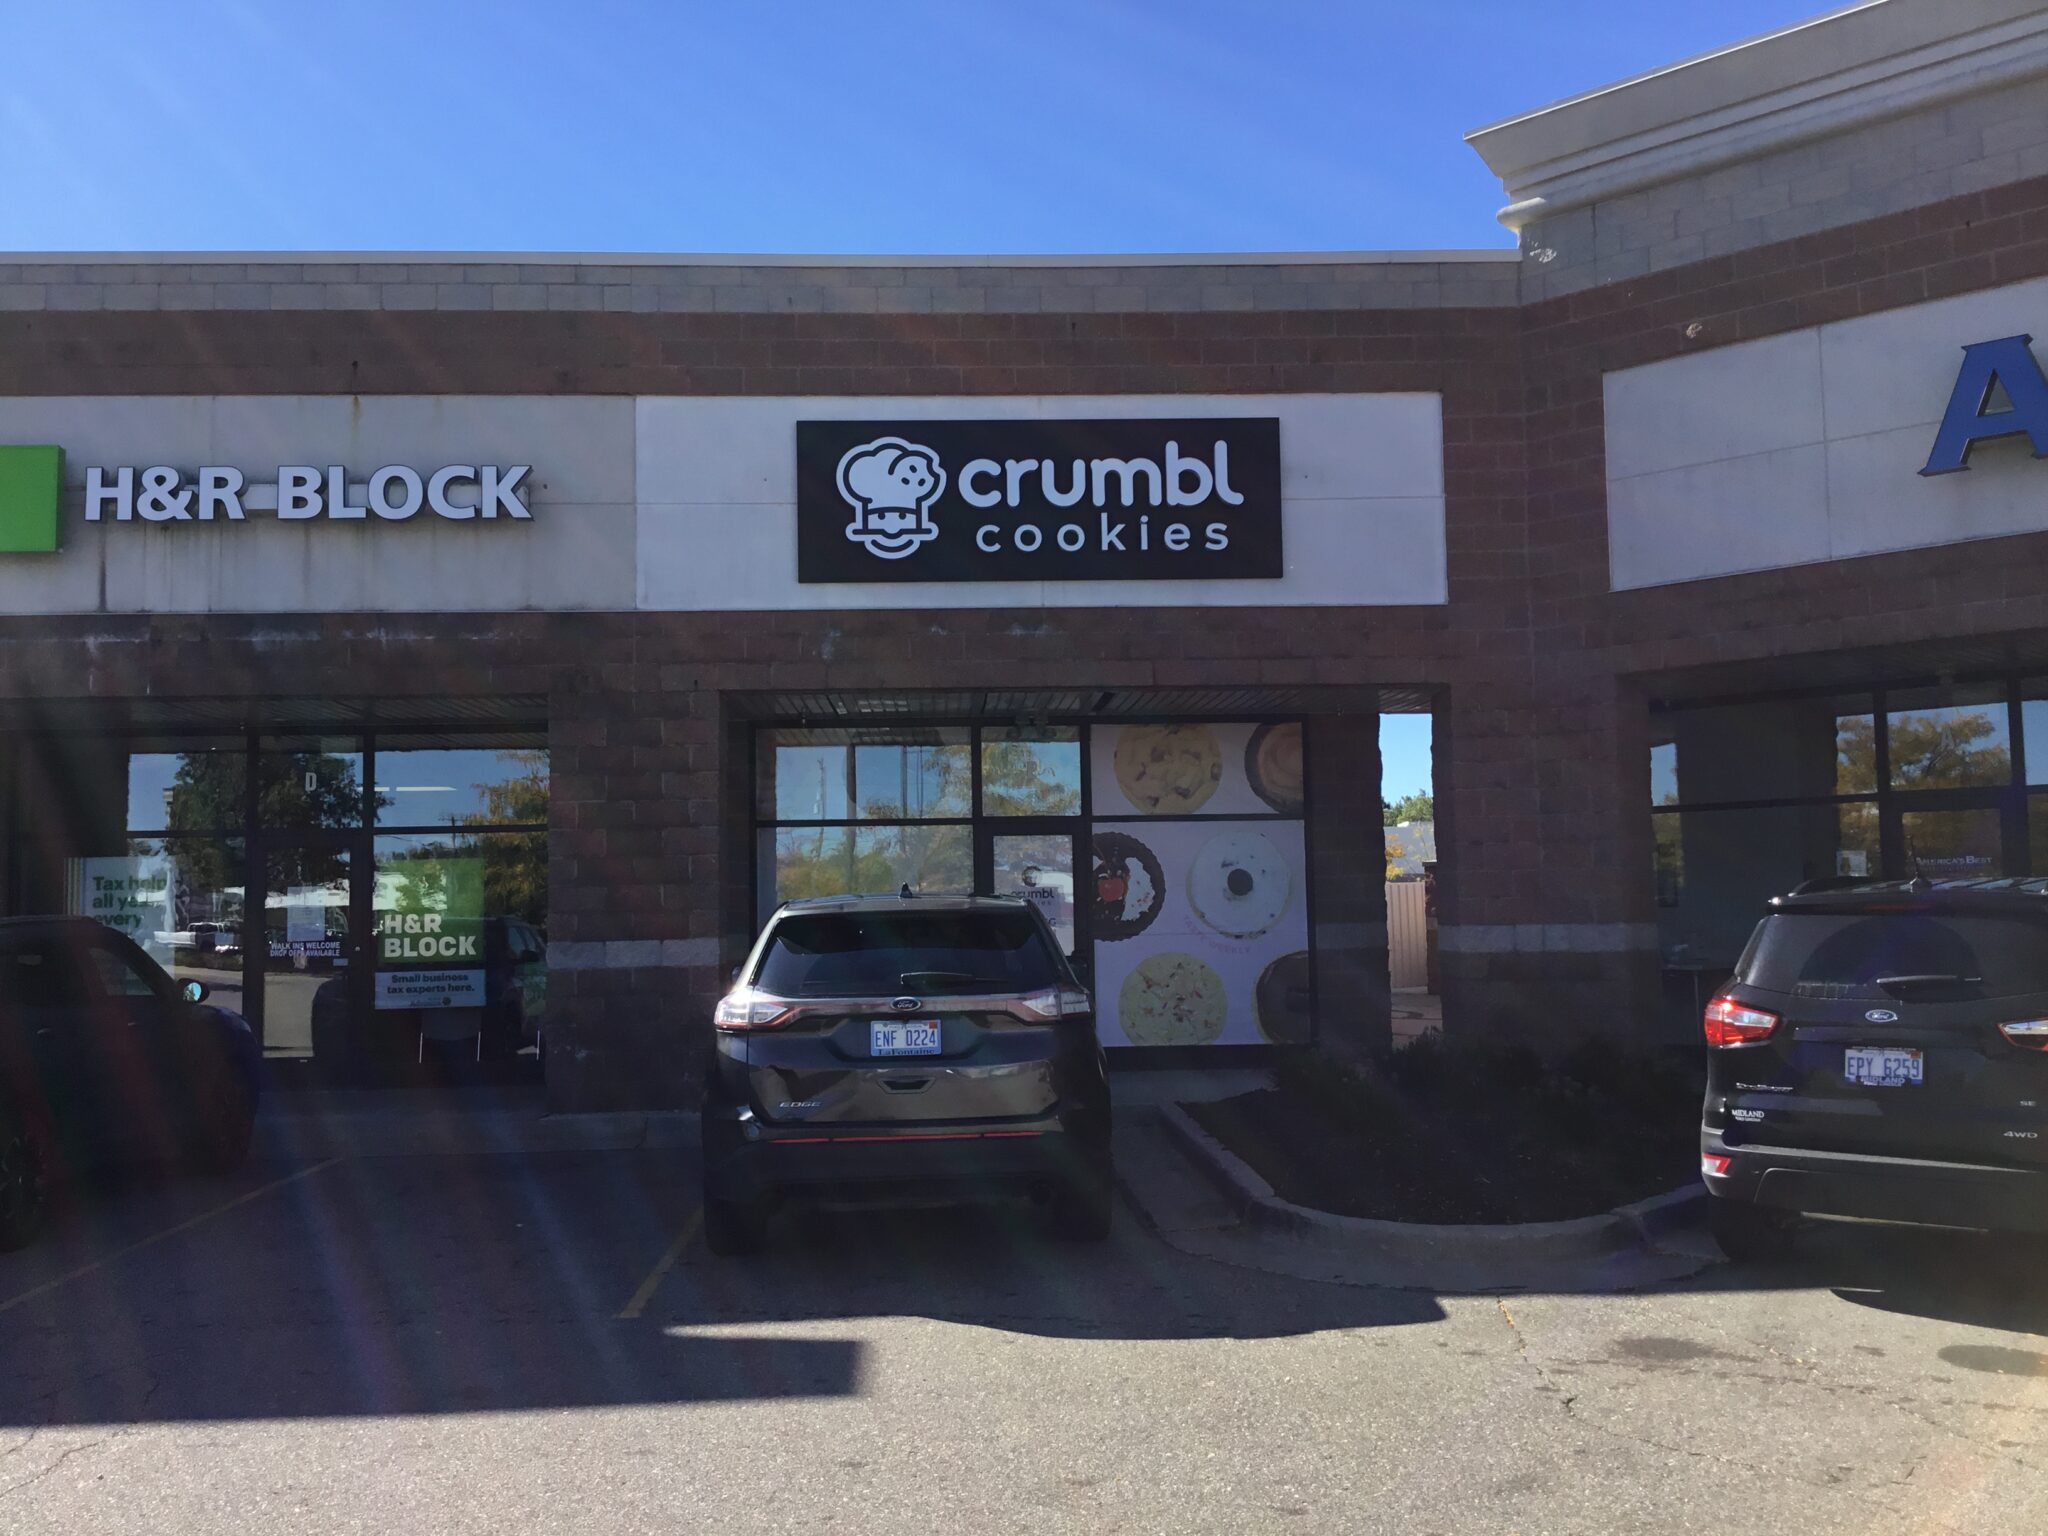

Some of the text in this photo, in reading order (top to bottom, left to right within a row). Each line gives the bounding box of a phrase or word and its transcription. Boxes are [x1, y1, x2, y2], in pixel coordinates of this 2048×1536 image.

[958, 440, 1244, 507] crumbl
[84, 464, 534, 522] H&R BLOCK
[976, 512, 1229, 552] cookies
[93, 876, 124, 891] Tax
[93, 892, 113, 909] all
[384, 913, 442, 934] H&R
[271, 942, 291, 950] WALK
[306, 941, 341, 950] WELCOME
[305, 949, 341, 957] AVAILABLE
[384, 936, 477, 957] BLOCK
[391, 972, 469, 983] Small business
[387, 986, 404, 994] tax
[406, 985, 446, 995] experts
[875, 1030, 897, 1048] ENF
[1847, 1056, 1920, 1079] EPY 6259
[1731, 1109, 1765, 1118] MIDLAND
[2003, 1130, 2039, 1139] 4WD
